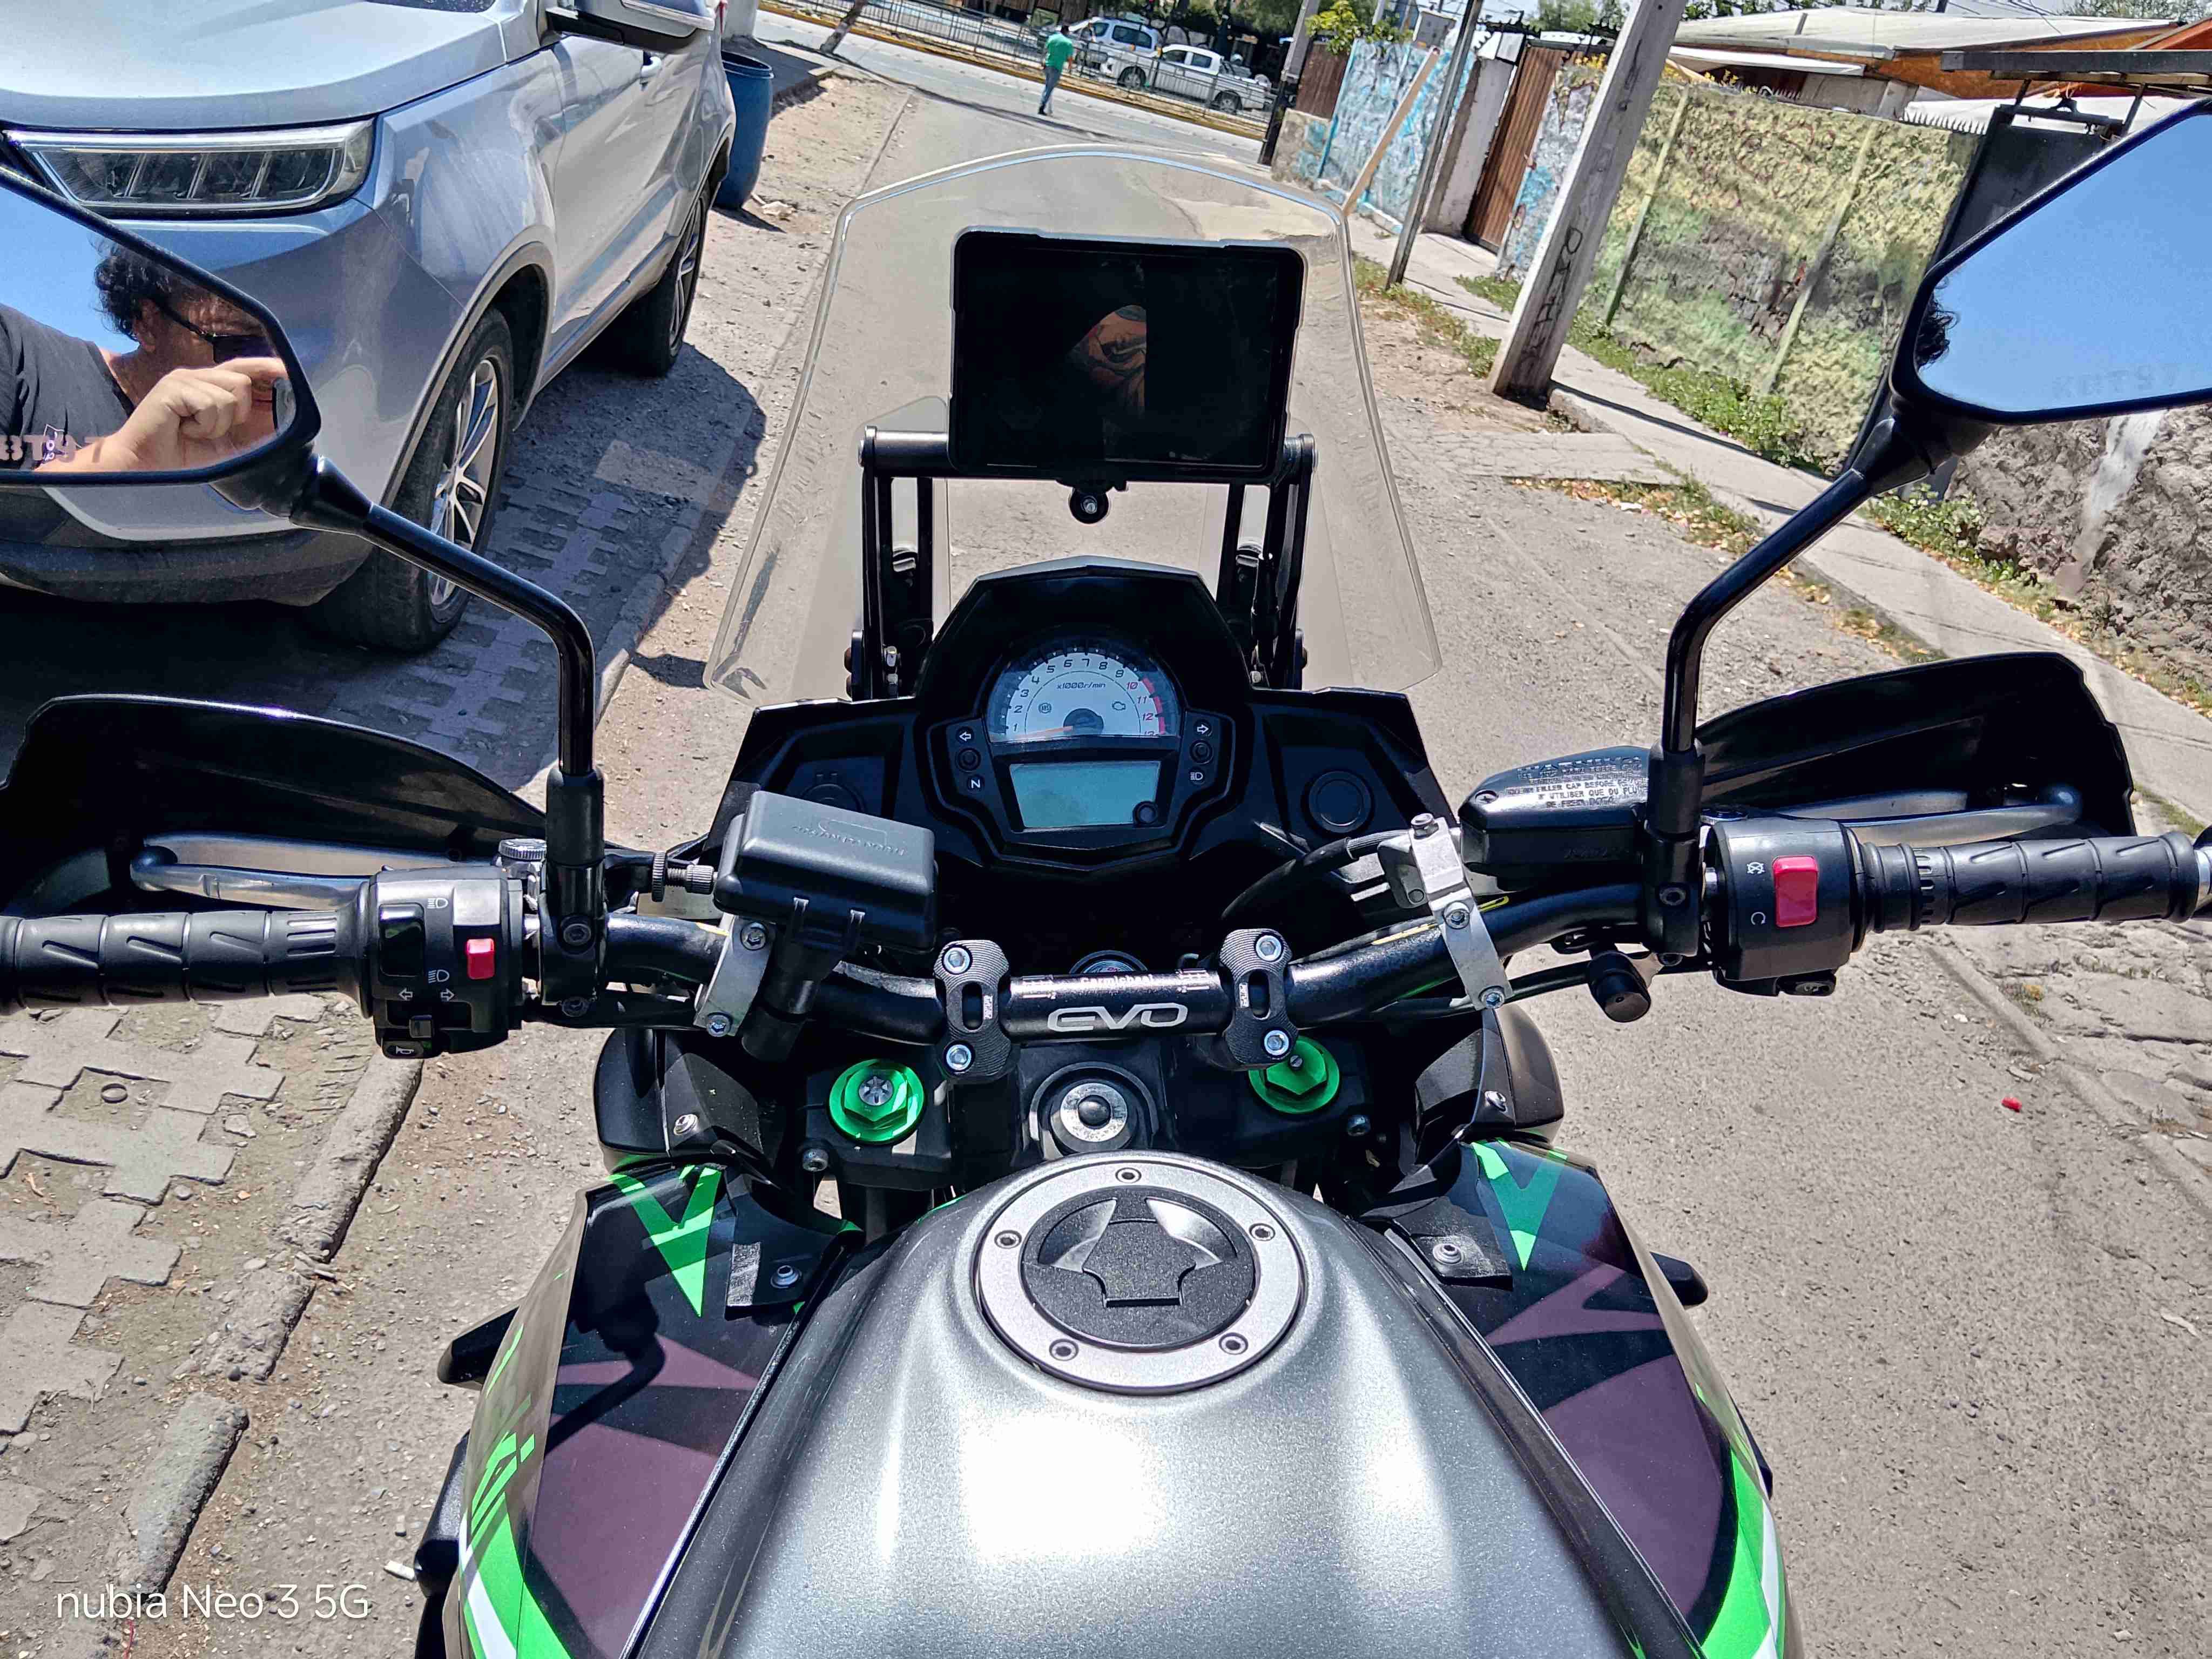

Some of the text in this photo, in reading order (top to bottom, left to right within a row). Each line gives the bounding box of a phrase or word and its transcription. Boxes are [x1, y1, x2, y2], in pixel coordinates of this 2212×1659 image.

[1064, 659, 1073, 667] 6
[1082, 658, 1090, 667] 7
[1098, 662, 1108, 670] 8
[1046, 665, 1056, 673] 5
[1115, 670, 1124, 678] 9
[1031, 676, 1040, 684] 4
[1127, 682, 1138, 690] 10
[1020, 689, 1029, 697] 3
[1137, 696, 1148, 704] 11
[1014, 705, 1023, 713] 2
[1142, 713, 1154, 721] 12
[1013, 723, 1019, 732] 1
[971, 779, 980, 788] N
[1047, 1002, 1189, 1033] EVO
